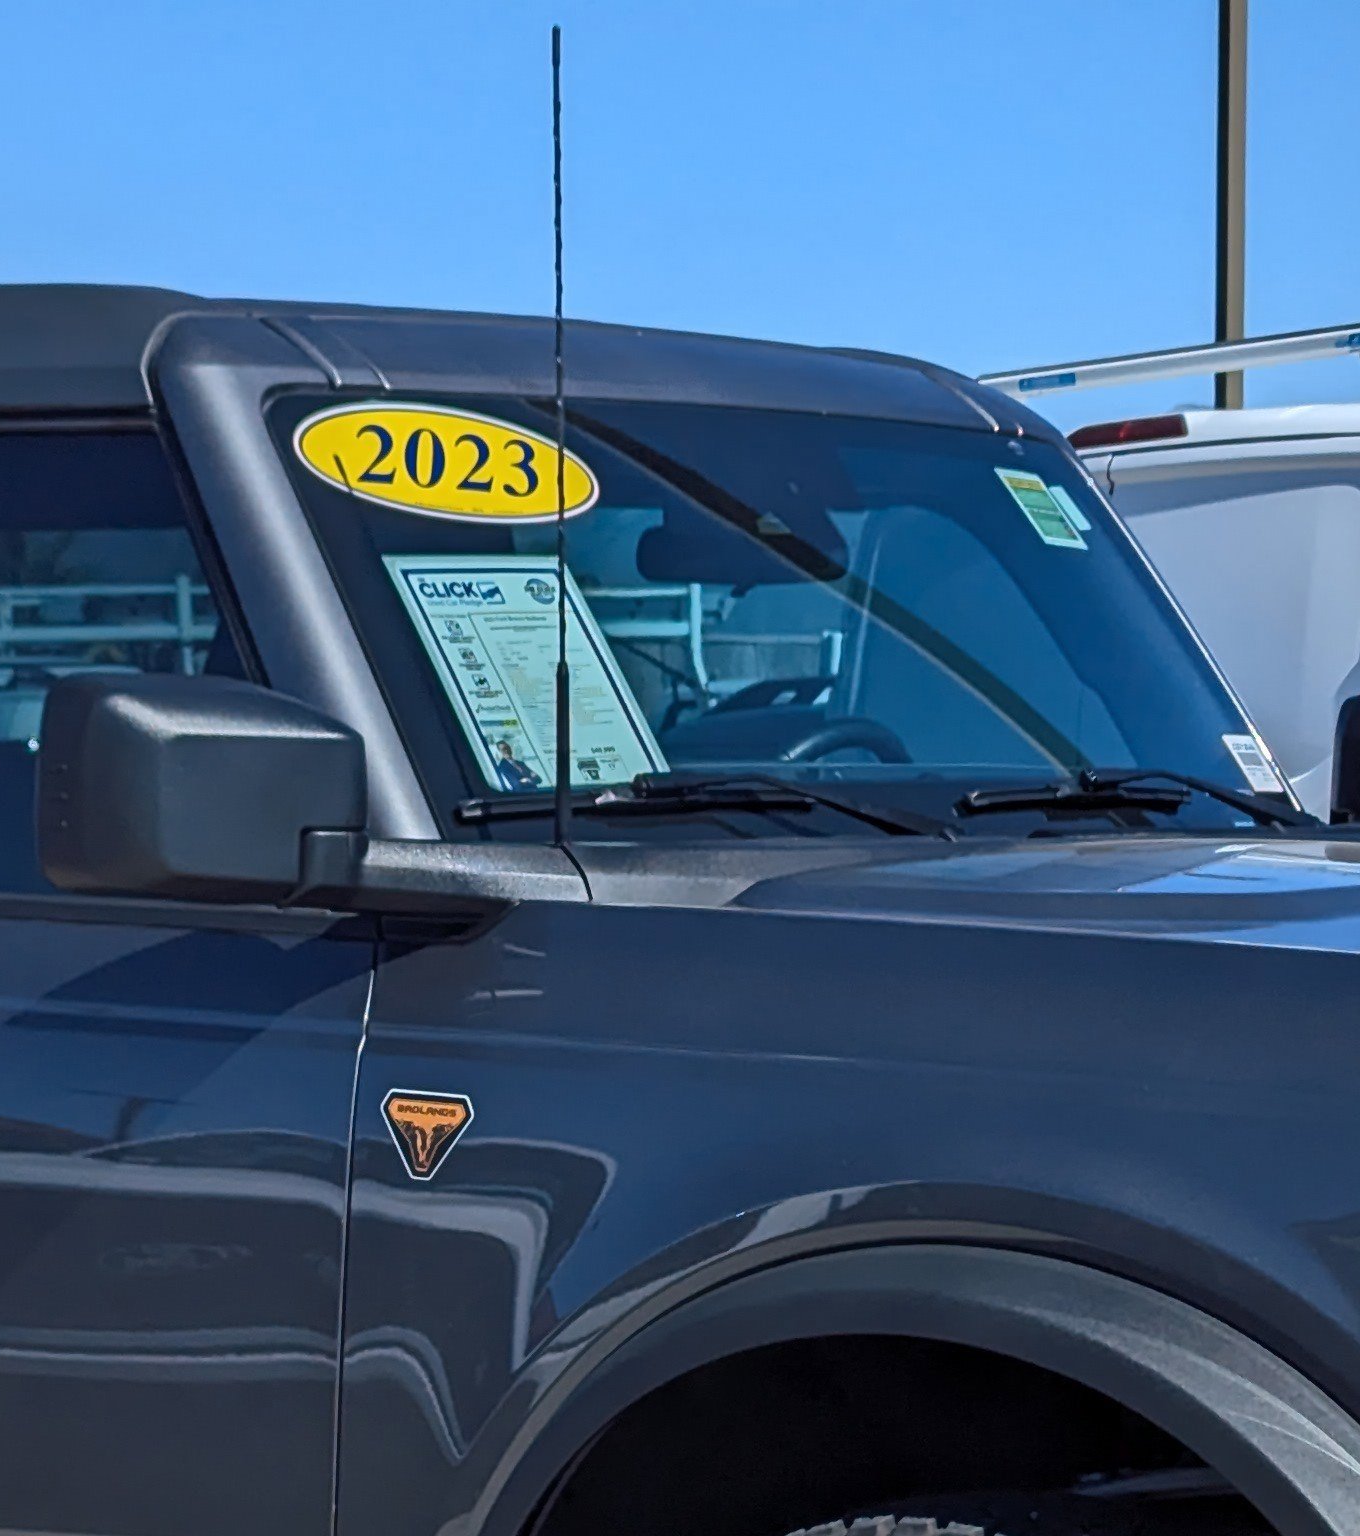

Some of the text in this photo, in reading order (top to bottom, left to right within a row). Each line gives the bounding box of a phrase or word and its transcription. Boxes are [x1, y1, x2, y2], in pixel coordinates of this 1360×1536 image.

[356, 424, 539, 498] 2023
[418, 581, 480, 599] CLICK
[397, 1104, 457, 1118] BADLANDS
